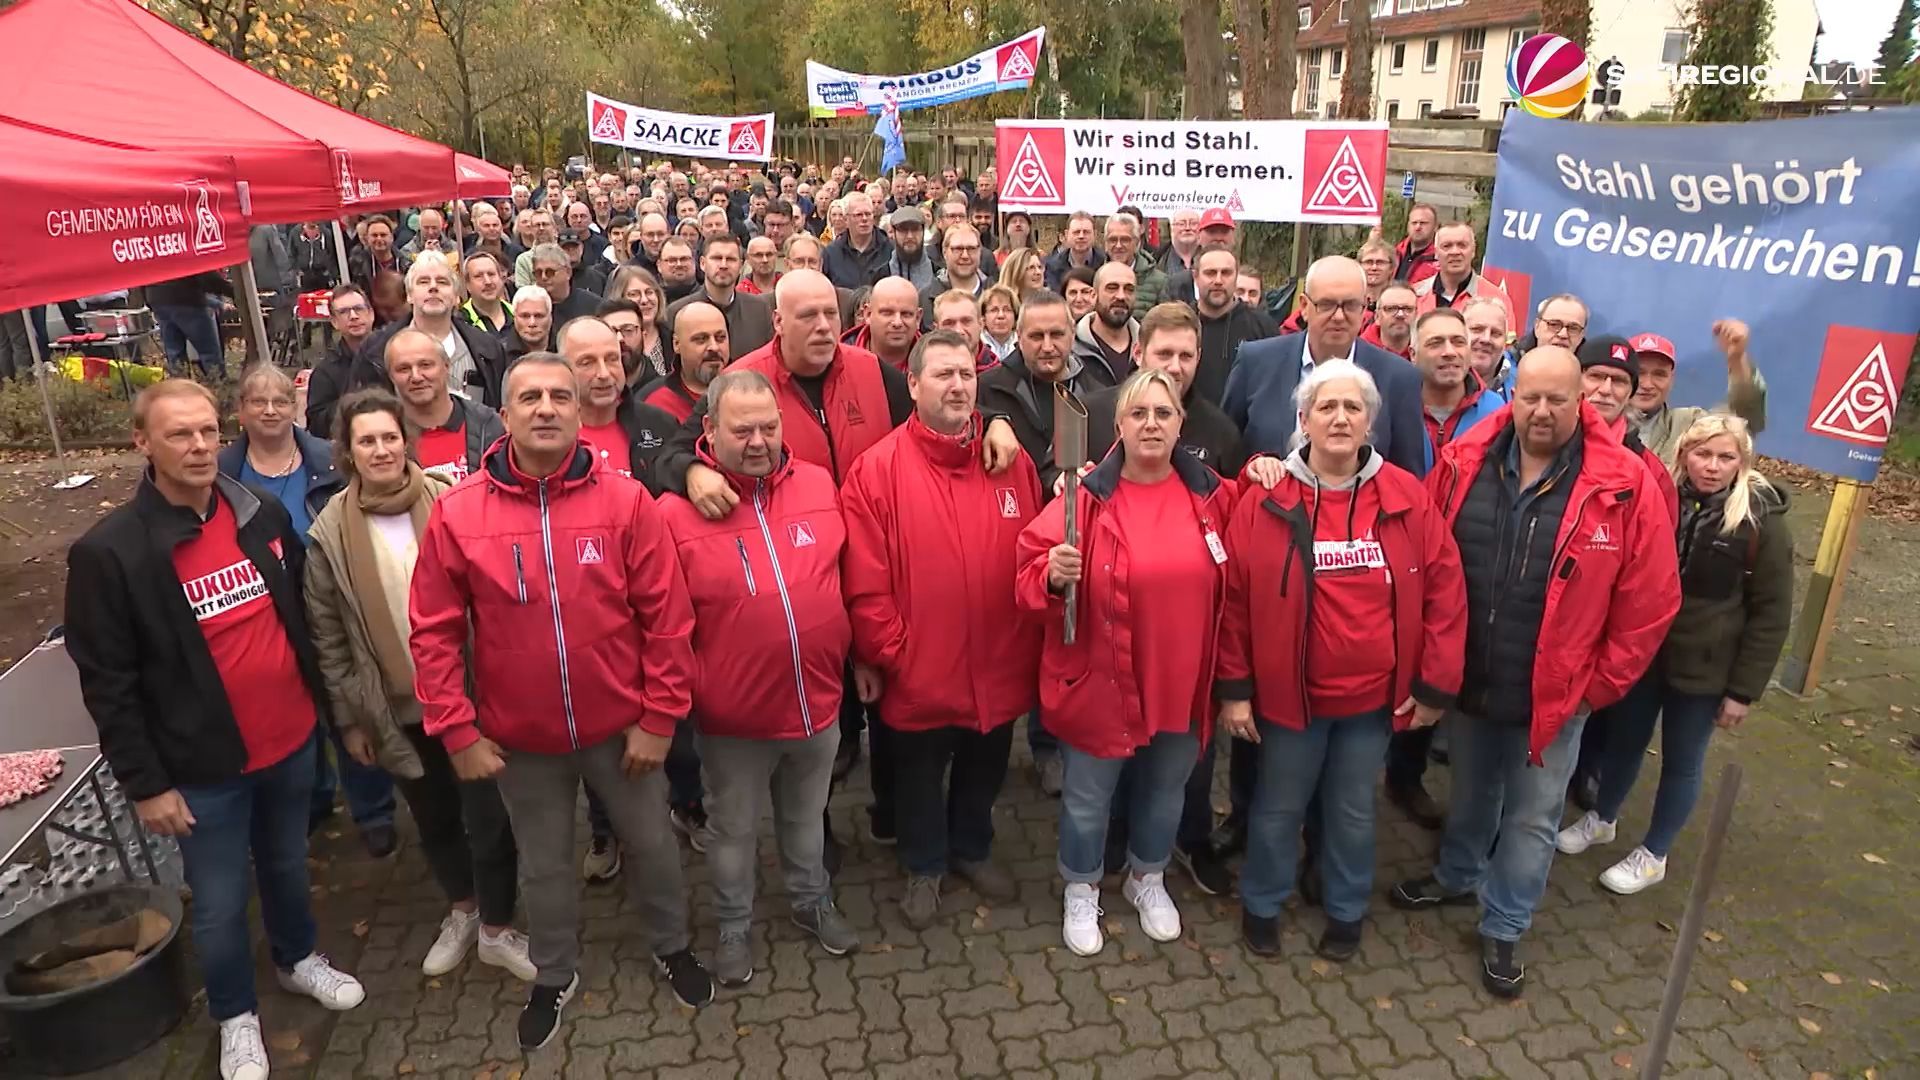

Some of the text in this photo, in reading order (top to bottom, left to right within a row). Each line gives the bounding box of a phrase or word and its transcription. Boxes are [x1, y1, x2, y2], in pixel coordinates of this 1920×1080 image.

[634, 118, 722, 147] SAACKE
[1073, 129, 1259, 151] Wir sind Stahl.
[1075, 157, 1293, 180] Wir sind Bremen.
[1555, 153, 1863, 214] Stahl gehört
[1110, 184, 1226, 206] Vertrauensleute
[47, 202, 184, 236] GEMEINSAM FÜR EIN
[112, 232, 188, 263] GUTES LEBEN
[1502, 206, 1920, 288] zu Gelsenkirchen!
[1313, 543, 1381, 568] LIDARITÄT
[193, 584, 267, 617] ATT KÜNDIGU
